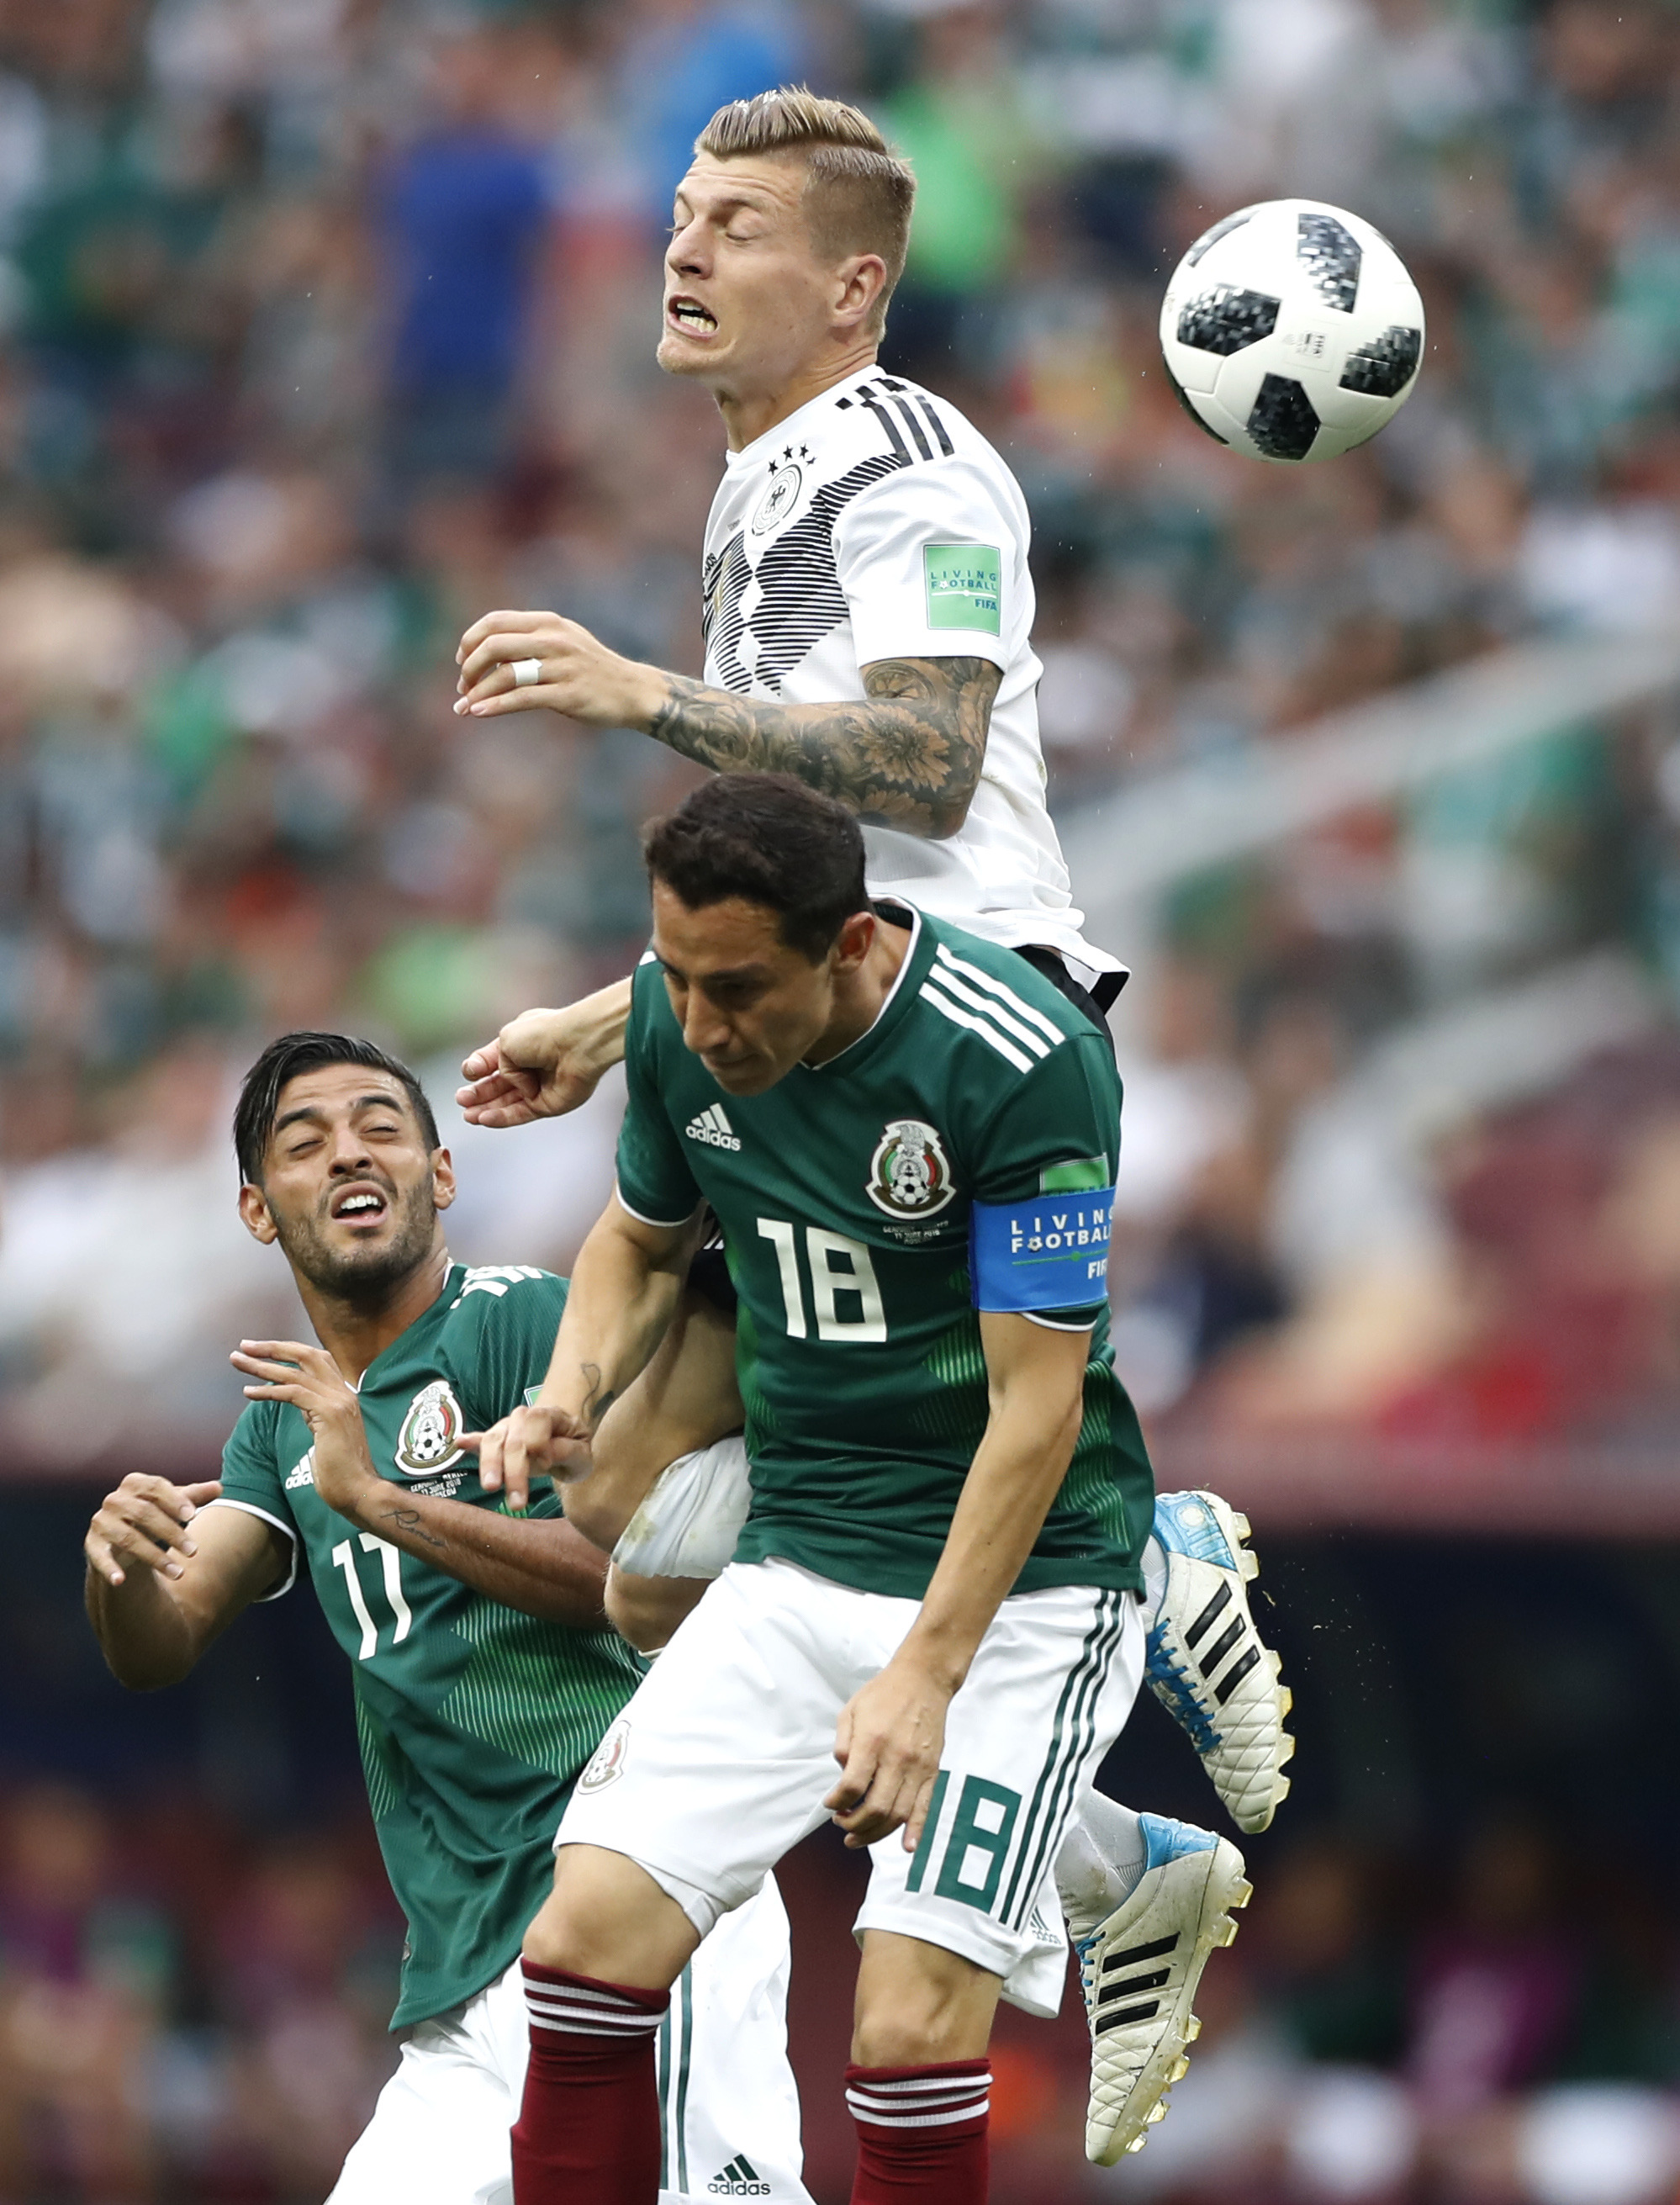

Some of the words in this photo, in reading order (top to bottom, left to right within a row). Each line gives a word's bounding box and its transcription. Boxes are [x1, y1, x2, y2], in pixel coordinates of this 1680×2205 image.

[930, 569, 996, 581] LIVING
[930, 579, 996, 591] FOOTBALL
[975, 599, 997, 611] FIFA
[685, 1125, 741, 1151] adidas
[1087, 1258, 1108, 1280] FIF
[757, 1218, 886, 1342] 18
[285, 1469, 314, 1489] adid
[331, 1531, 412, 1661] 17
[905, 1769, 1022, 1915] 18
[707, 2181, 771, 2196] adidas
